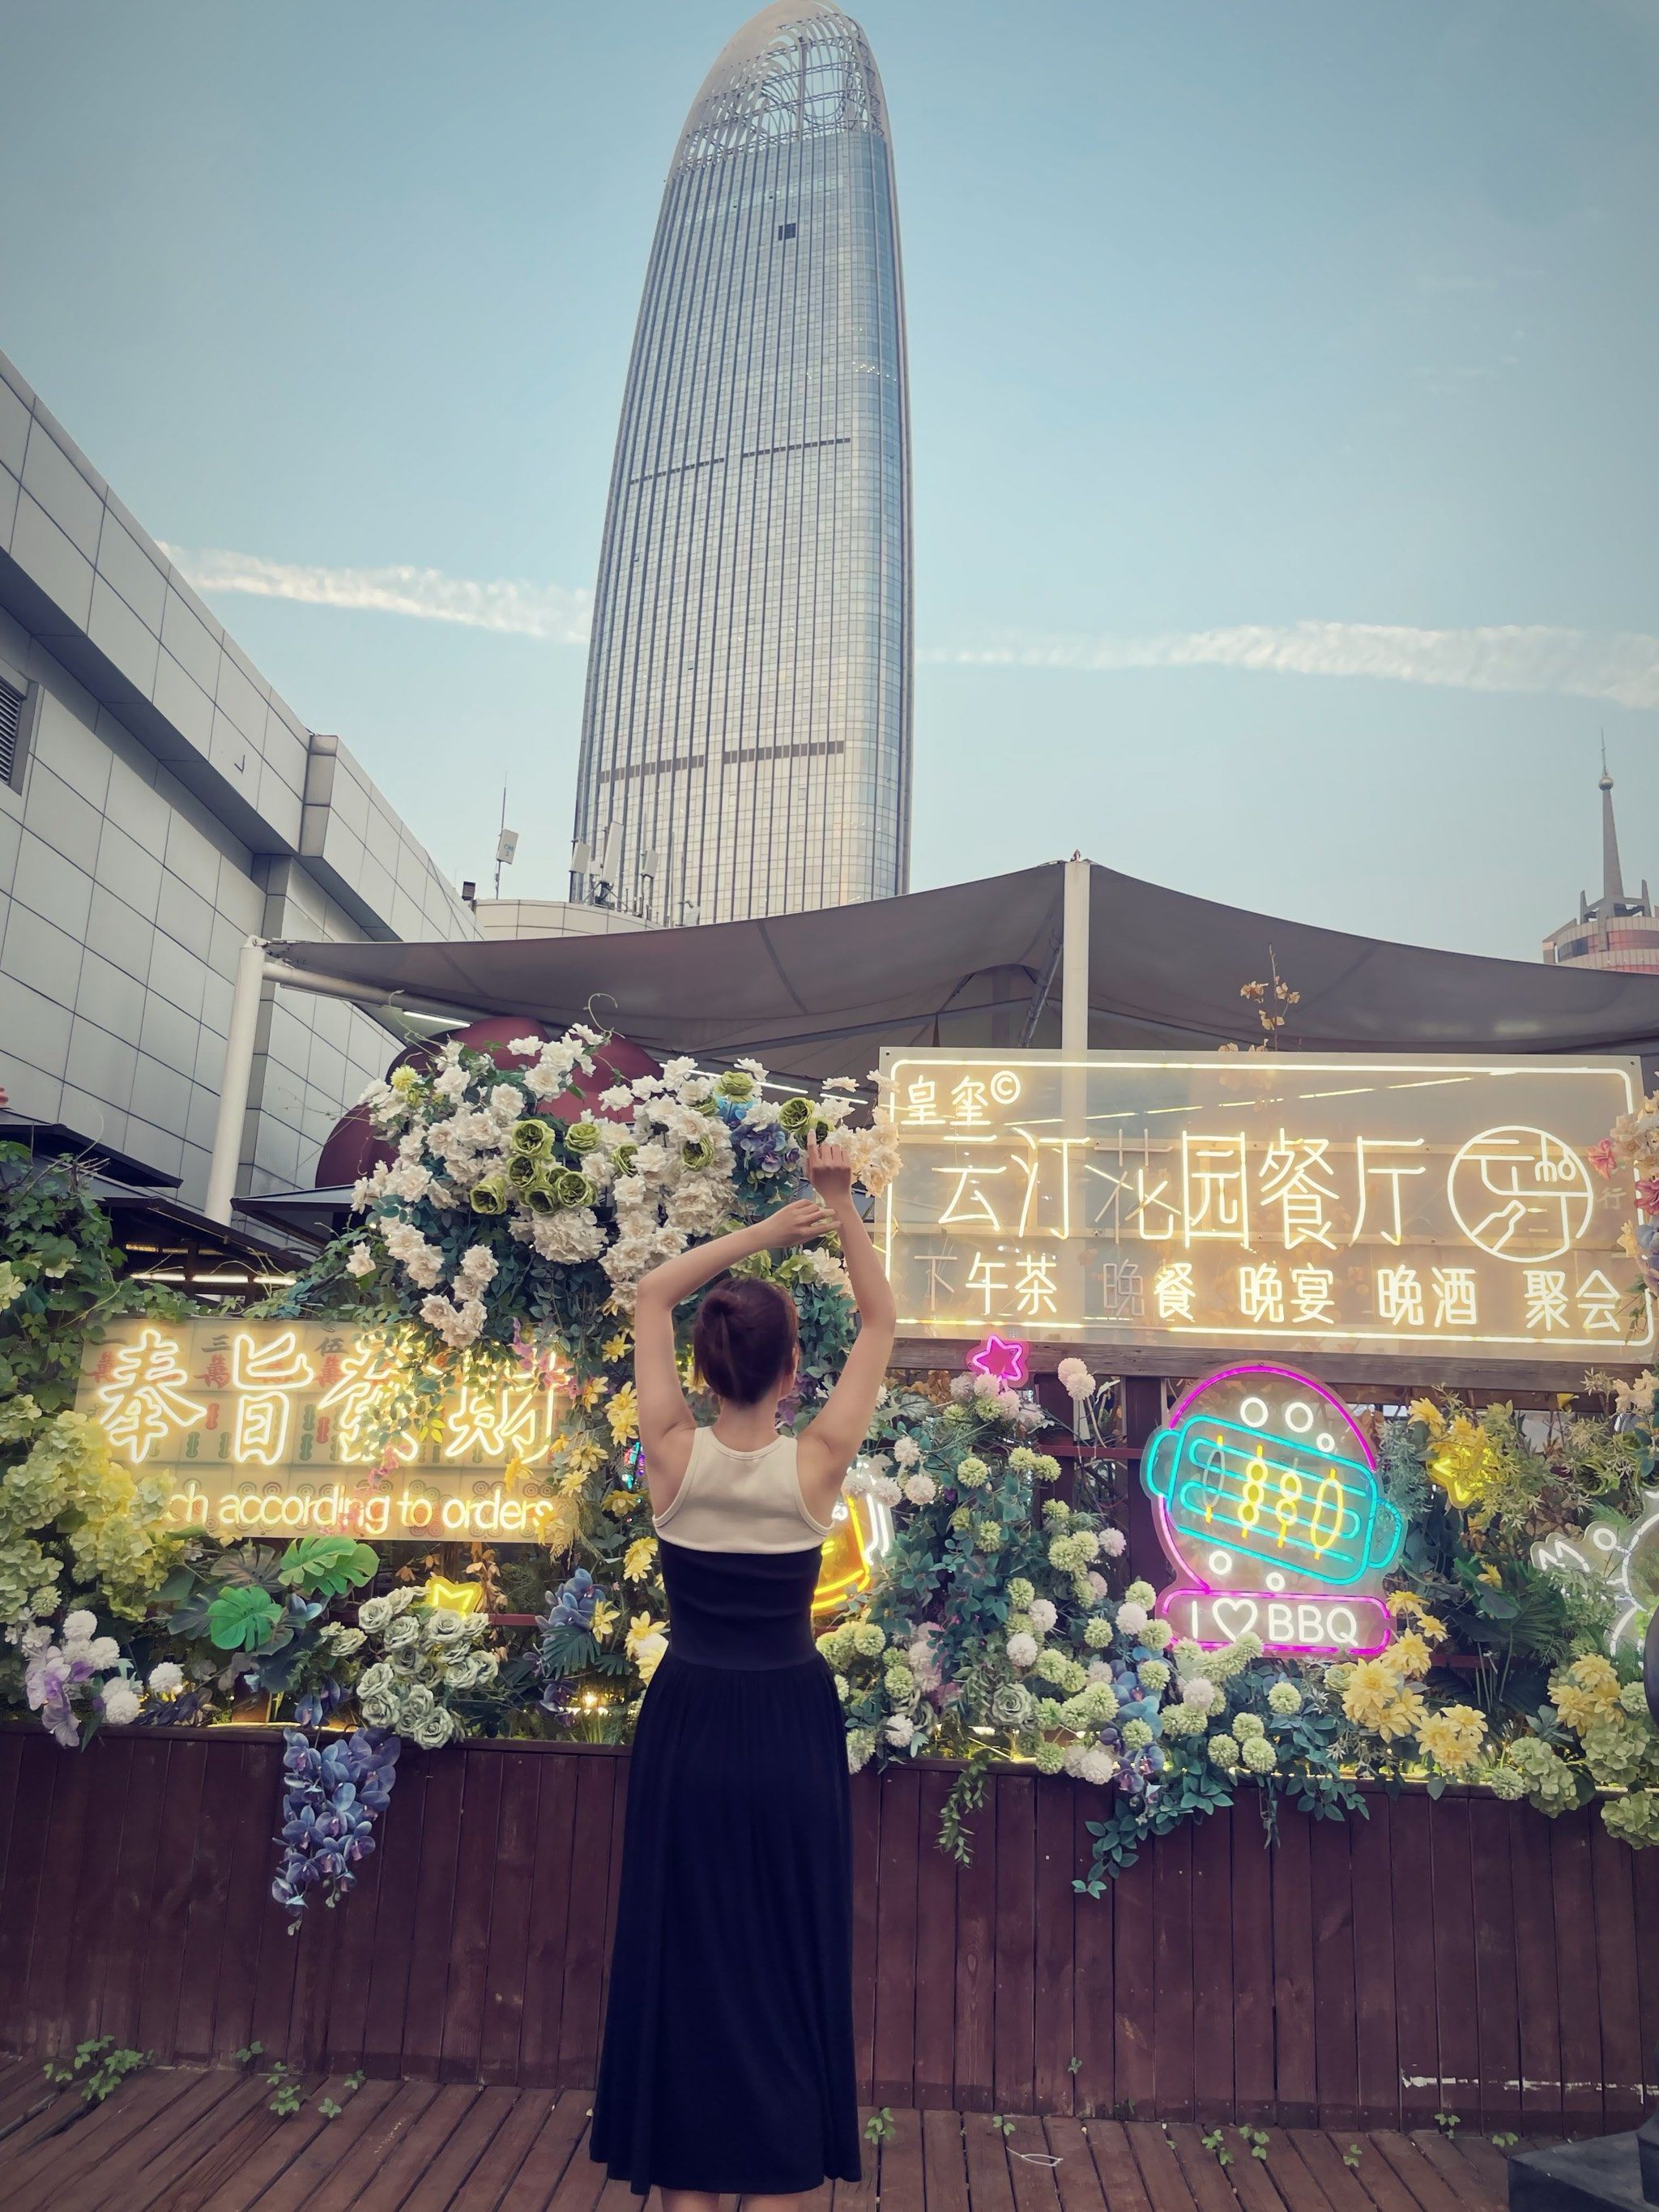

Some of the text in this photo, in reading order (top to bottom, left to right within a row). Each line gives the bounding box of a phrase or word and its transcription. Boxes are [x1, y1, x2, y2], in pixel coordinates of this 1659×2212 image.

[932, 1127, 1426, 1250] 云汀花园餐厅
[915, 1252, 1621, 1332] 下午茶 晚餐 晚宴 晚酒 聚会
[220, 1484, 390, 1535] according
[397, 1492, 433, 1527] to
[442, 1488, 554, 1530] orders
[1269, 1603, 1358, 1646] BBQ
